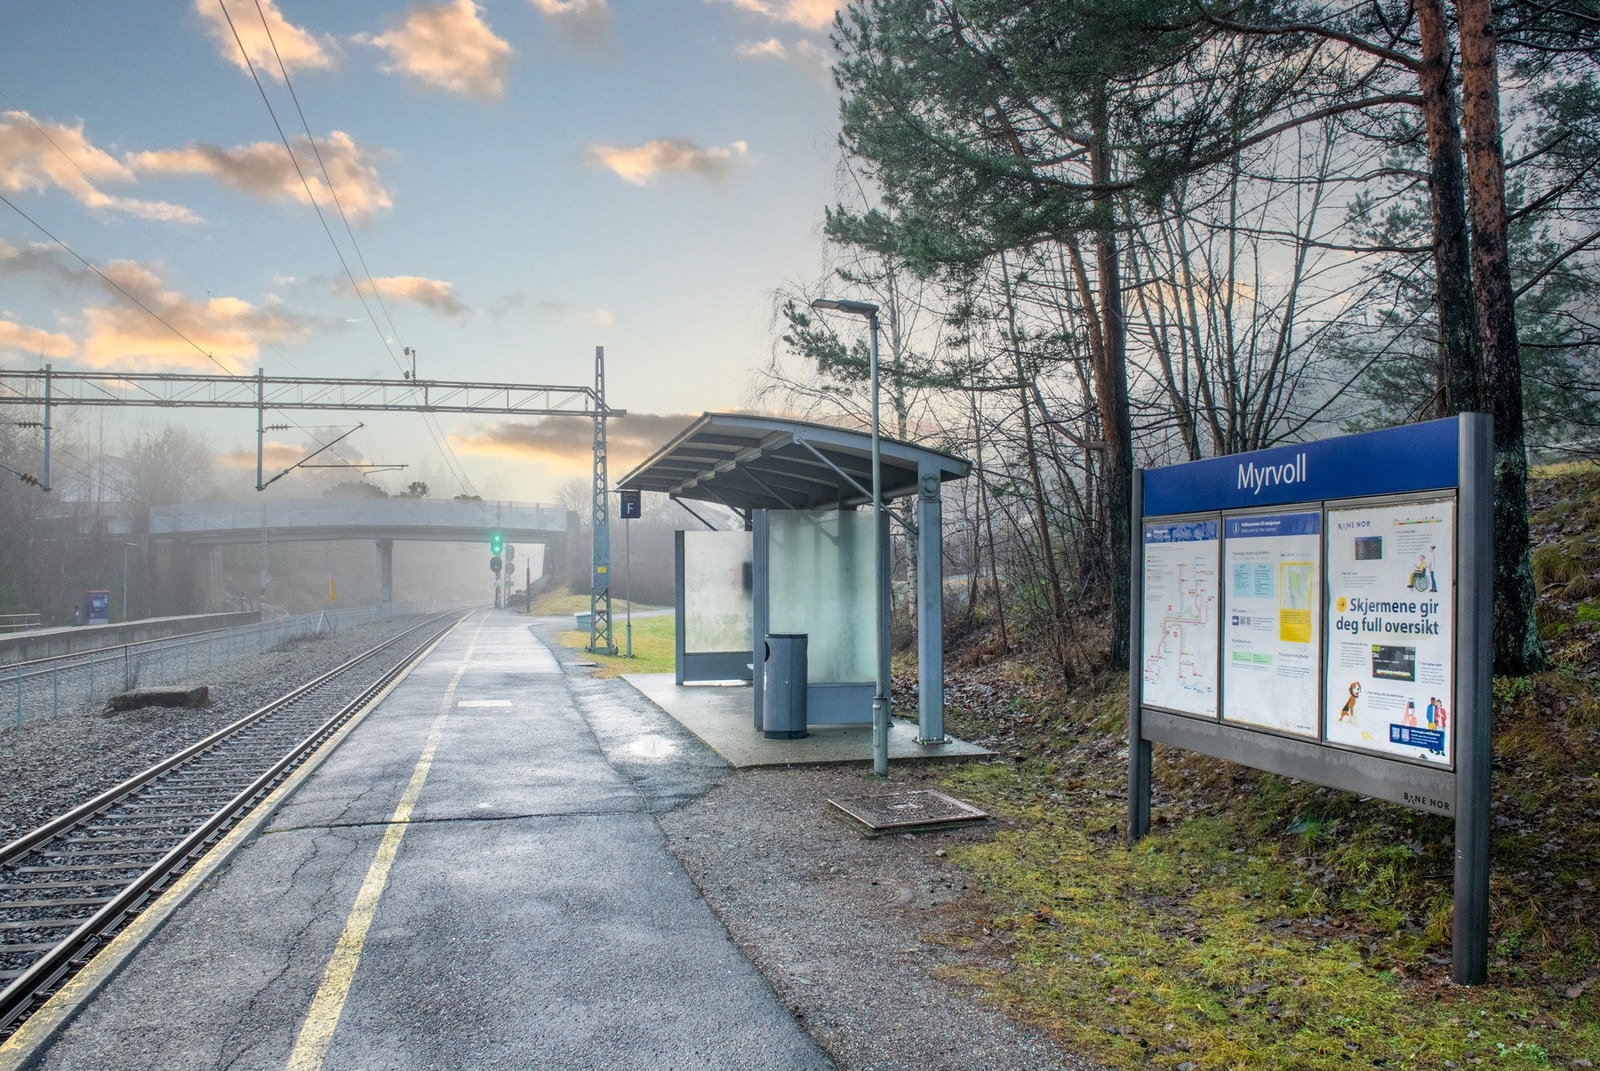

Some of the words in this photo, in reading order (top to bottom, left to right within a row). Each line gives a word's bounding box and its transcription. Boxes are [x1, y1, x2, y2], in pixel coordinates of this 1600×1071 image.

[1237, 452, 1306, 495] Myrvoll
[627, 502, 634, 514] F
[1338, 521, 1355, 531] BANE
[1356, 520, 1371, 528] NOR
[1350, 598, 1416, 616] Skjermene
[1420, 599, 1439, 617] gir
[1336, 616, 1359, 634] deg
[1361, 616, 1382, 632] full
[1385, 619, 1439, 635] oversikt
[1403, 792, 1427, 804] BANE
[1430, 799, 1450, 811] NOR
